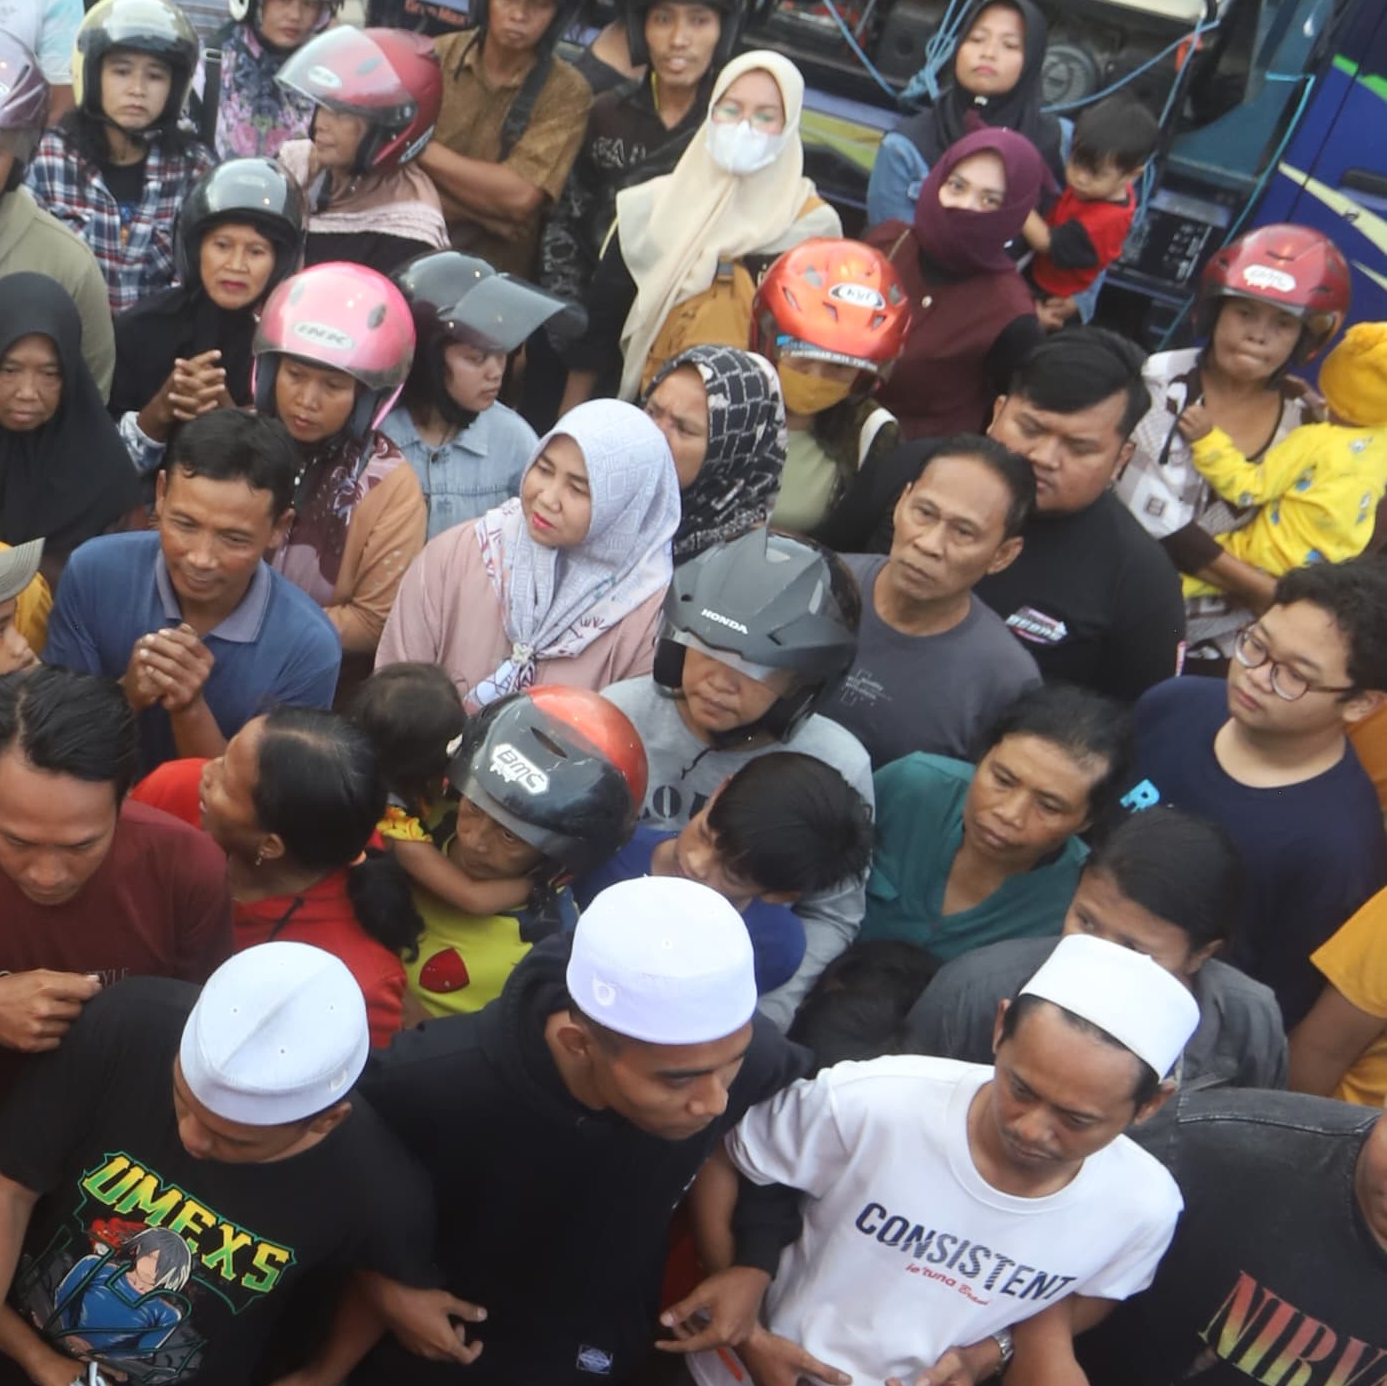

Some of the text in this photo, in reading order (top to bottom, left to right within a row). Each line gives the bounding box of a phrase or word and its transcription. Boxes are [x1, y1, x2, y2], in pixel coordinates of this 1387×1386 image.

[701, 608, 749, 635] HONDA
[496, 749, 540, 789] BMC
[81, 1154, 292, 1293] UMEXS
[854, 1201, 1076, 1303] CONSISTENT
